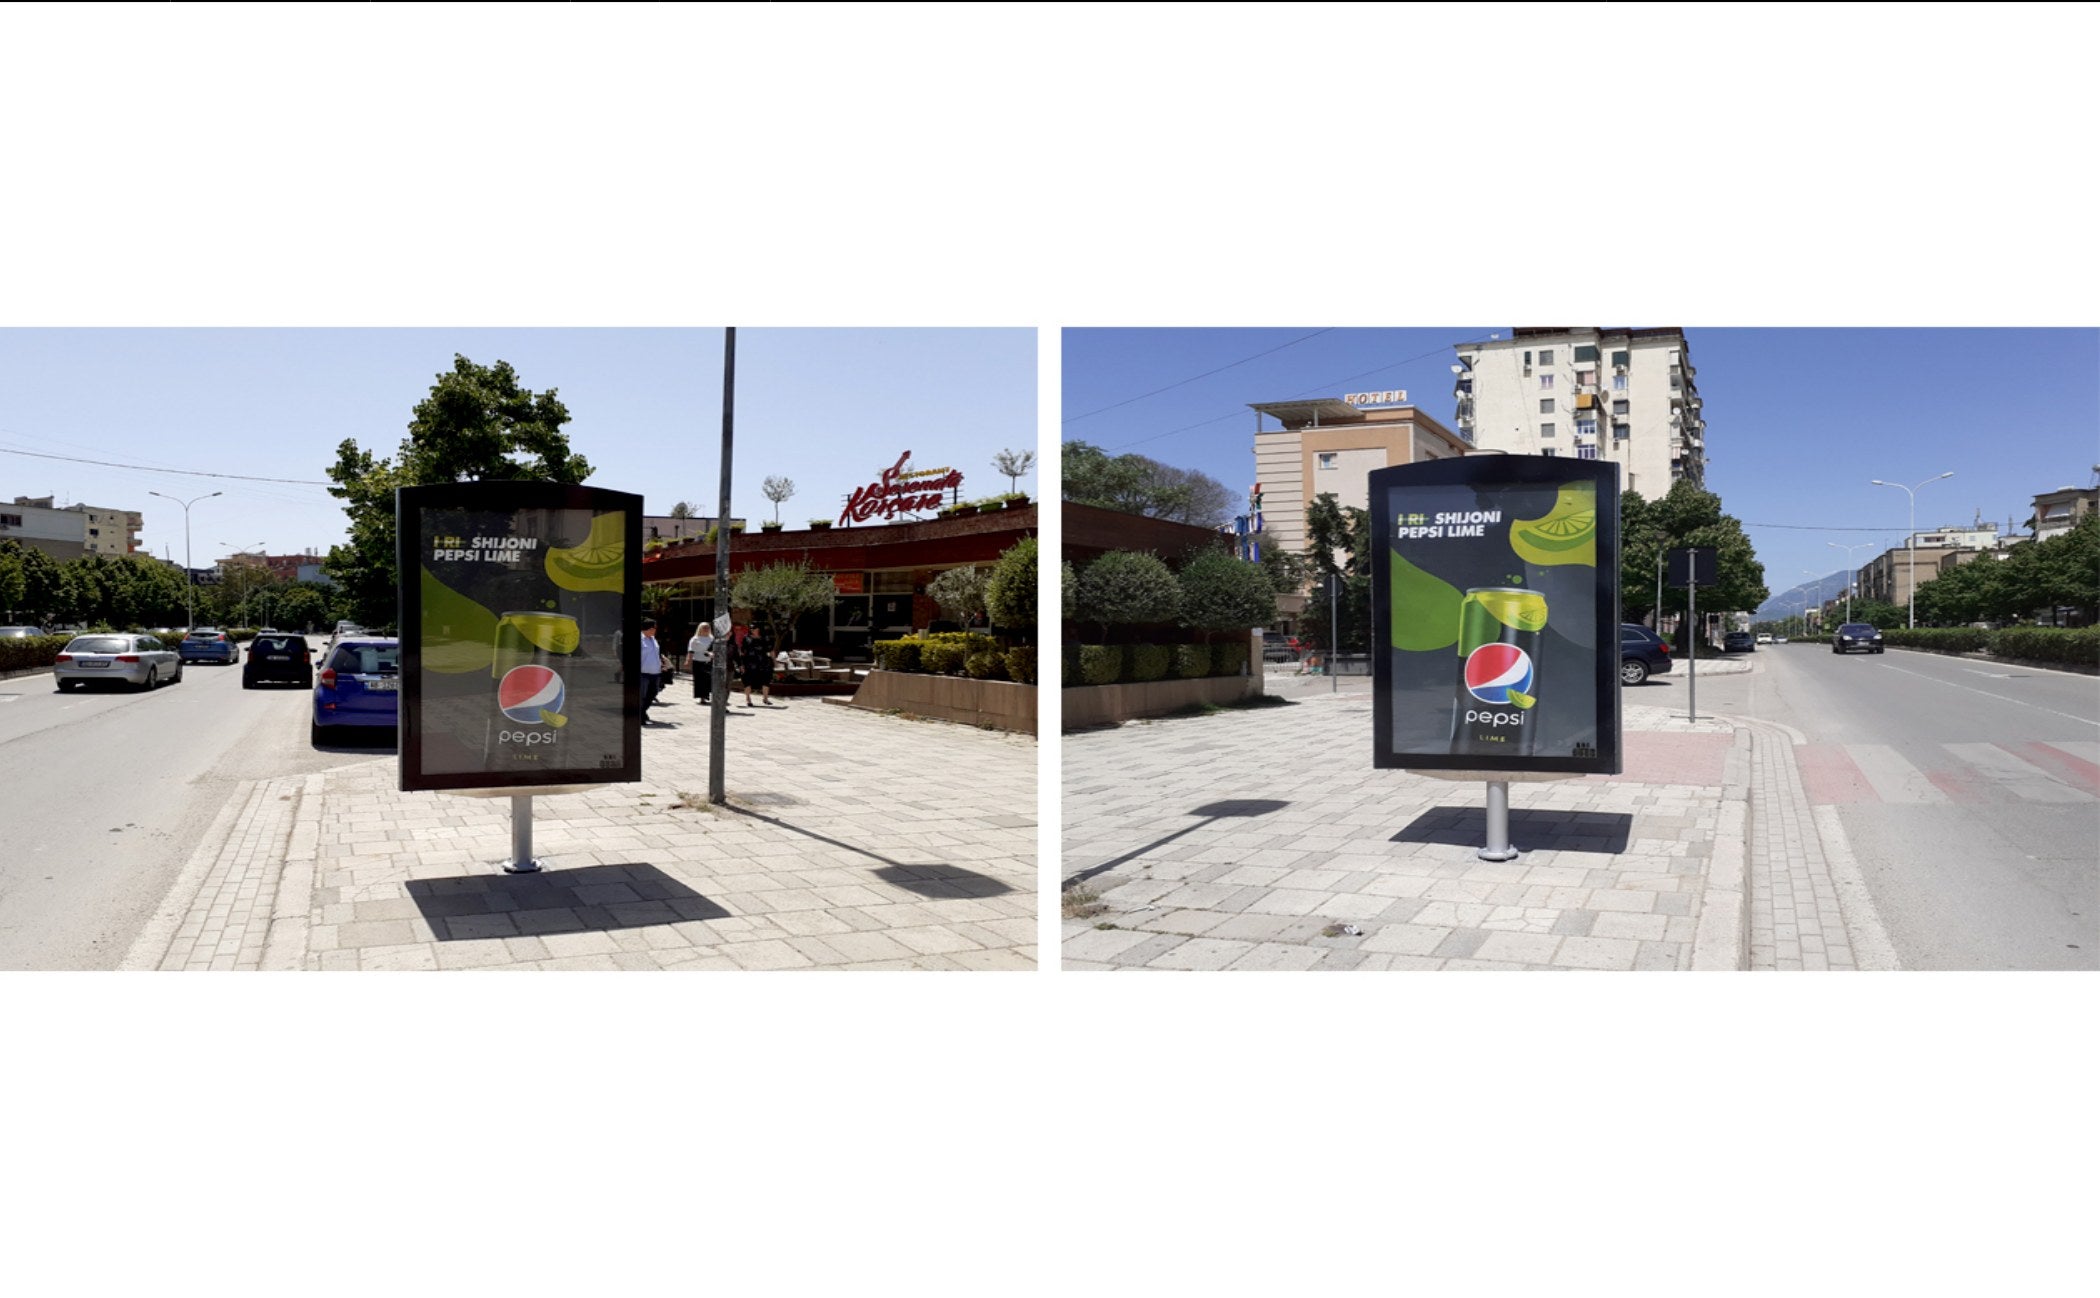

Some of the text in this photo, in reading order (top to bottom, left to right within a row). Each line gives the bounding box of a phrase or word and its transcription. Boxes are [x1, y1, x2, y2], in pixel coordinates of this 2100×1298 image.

[1345, 391, 1406, 405] HOTEL
[1434, 510, 1502, 525] SHIJONI
[1398, 524, 1485, 539] PEPSI LIME
[471, 536, 538, 550] SHIJONI
[433, 548, 521, 563] PEPSI LIME
[1464, 709, 1526, 728] pepsi
[498, 729, 558, 747] pepsi
[1479, 734, 1506, 743] LIME
